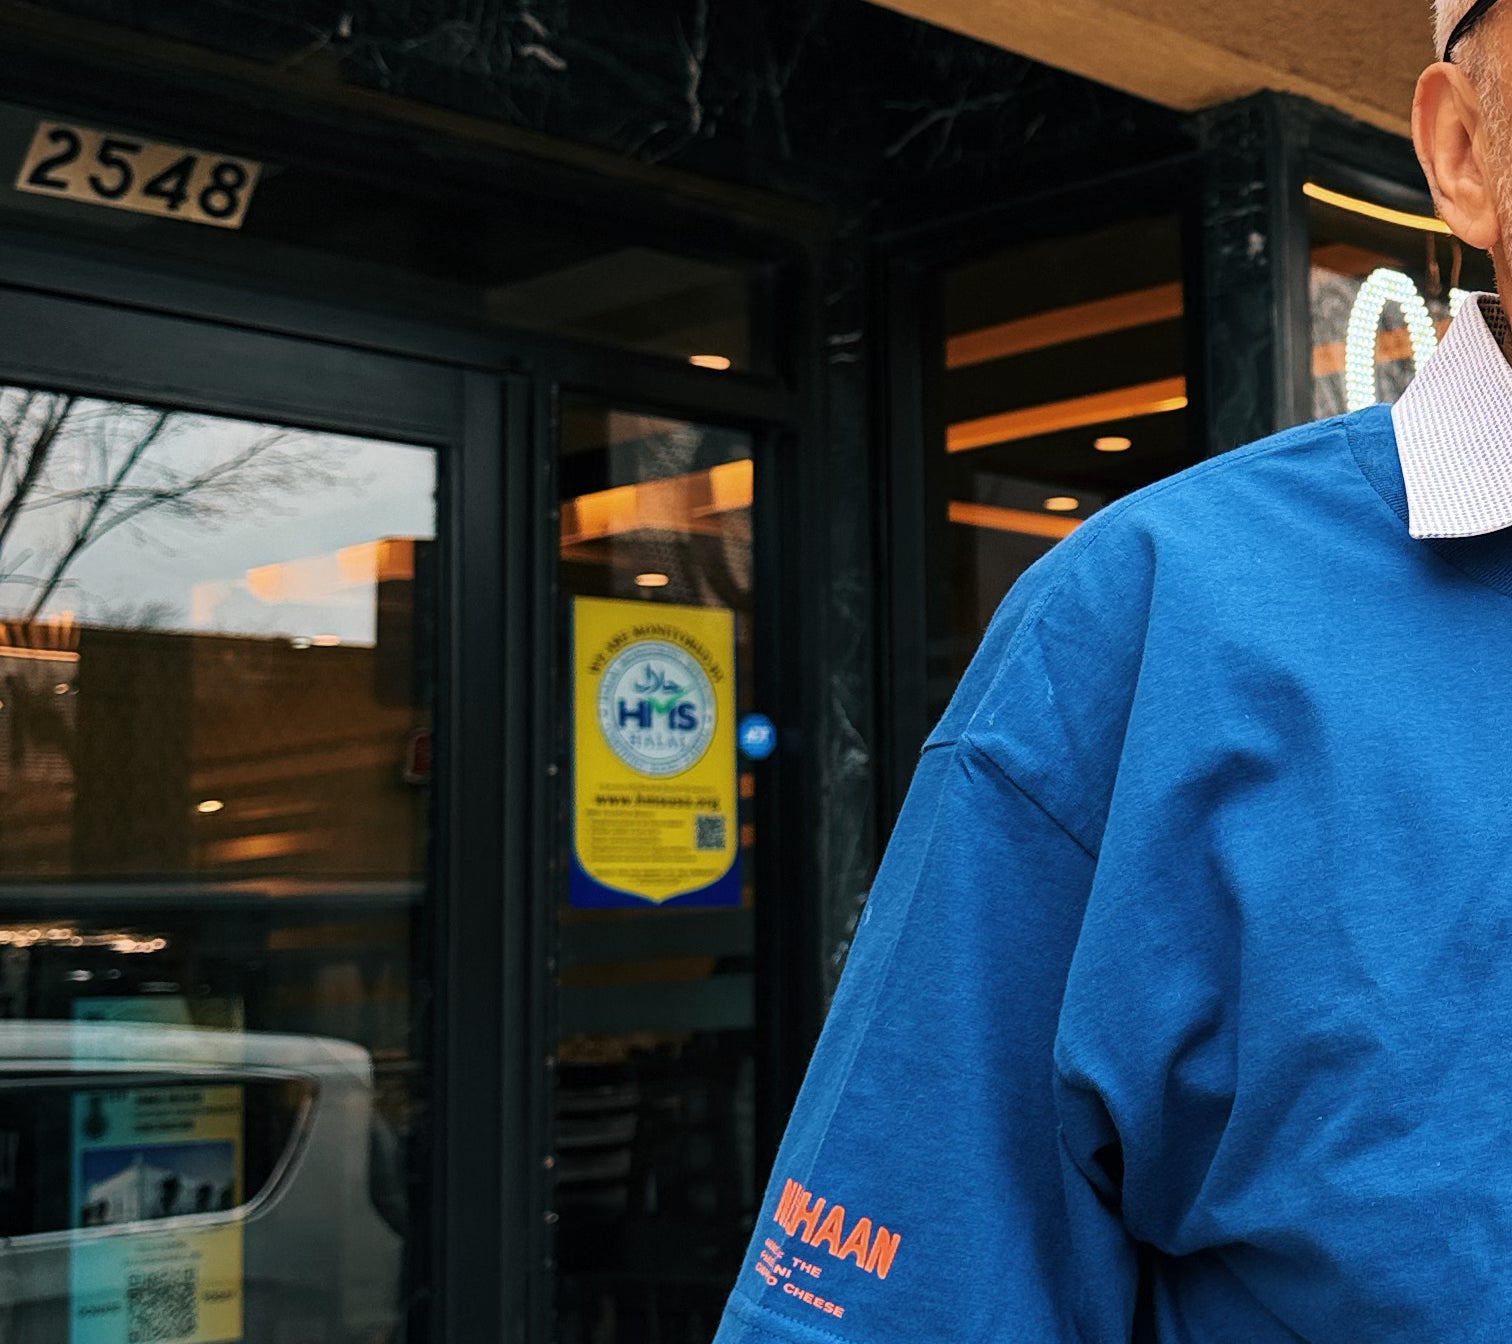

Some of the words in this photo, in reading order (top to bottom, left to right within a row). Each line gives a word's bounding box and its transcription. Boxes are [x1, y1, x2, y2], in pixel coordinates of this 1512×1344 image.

[28, 129, 247, 218] 2548
[792, 1256, 822, 1278] THE
[783, 1282, 846, 1319] CHEESE
